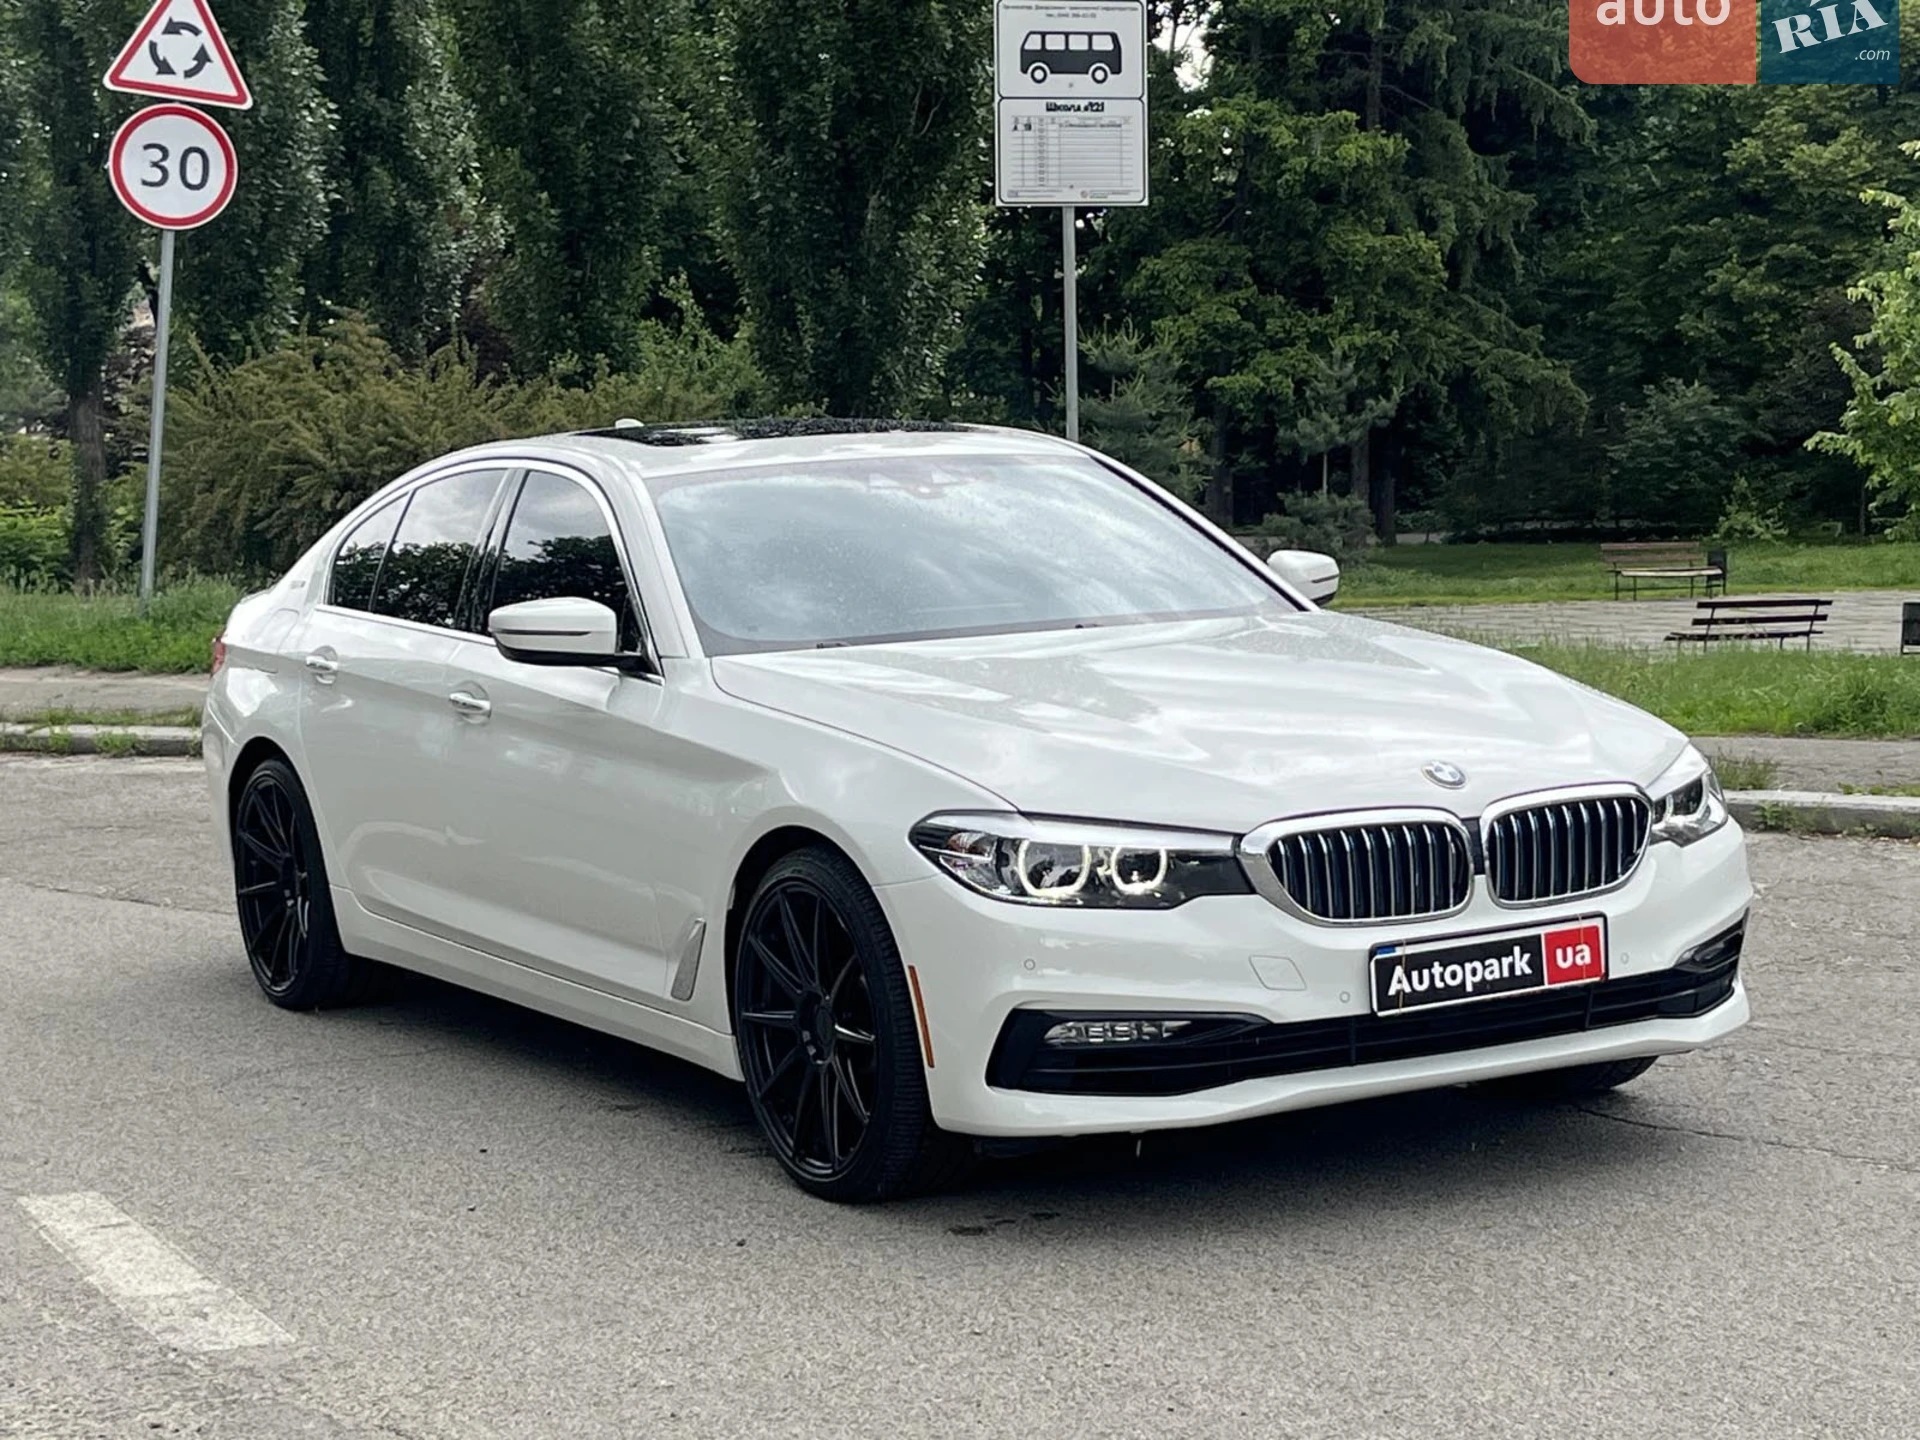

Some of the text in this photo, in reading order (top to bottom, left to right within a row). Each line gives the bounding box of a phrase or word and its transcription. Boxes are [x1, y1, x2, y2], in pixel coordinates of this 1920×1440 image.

[140, 143, 210, 191] 30
[1387, 943, 1592, 996] Autopark ua
